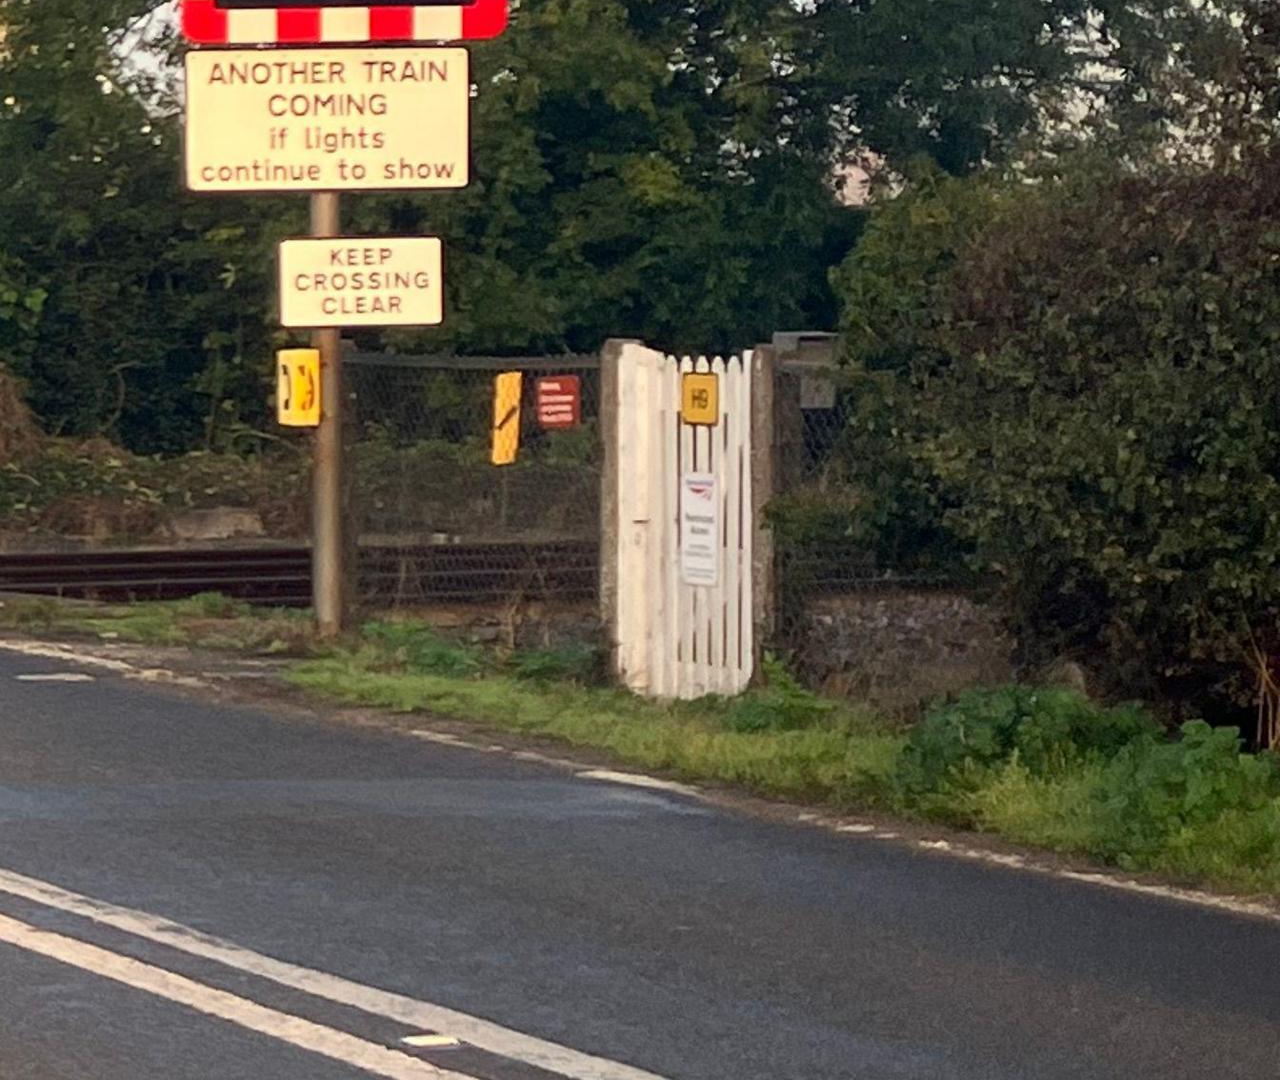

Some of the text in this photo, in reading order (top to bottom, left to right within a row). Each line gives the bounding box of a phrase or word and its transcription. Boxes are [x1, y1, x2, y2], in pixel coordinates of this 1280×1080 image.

[208, 60, 448, 85] ANOTHER TRAIN
[268, 94, 388, 117] COMING
[269, 127, 385, 153] if lights
[201, 158, 455, 182] continue to show
[330, 248, 393, 266] KEEP
[295, 272, 430, 292] CROSSING
[322, 296, 403, 315] CLEAR
